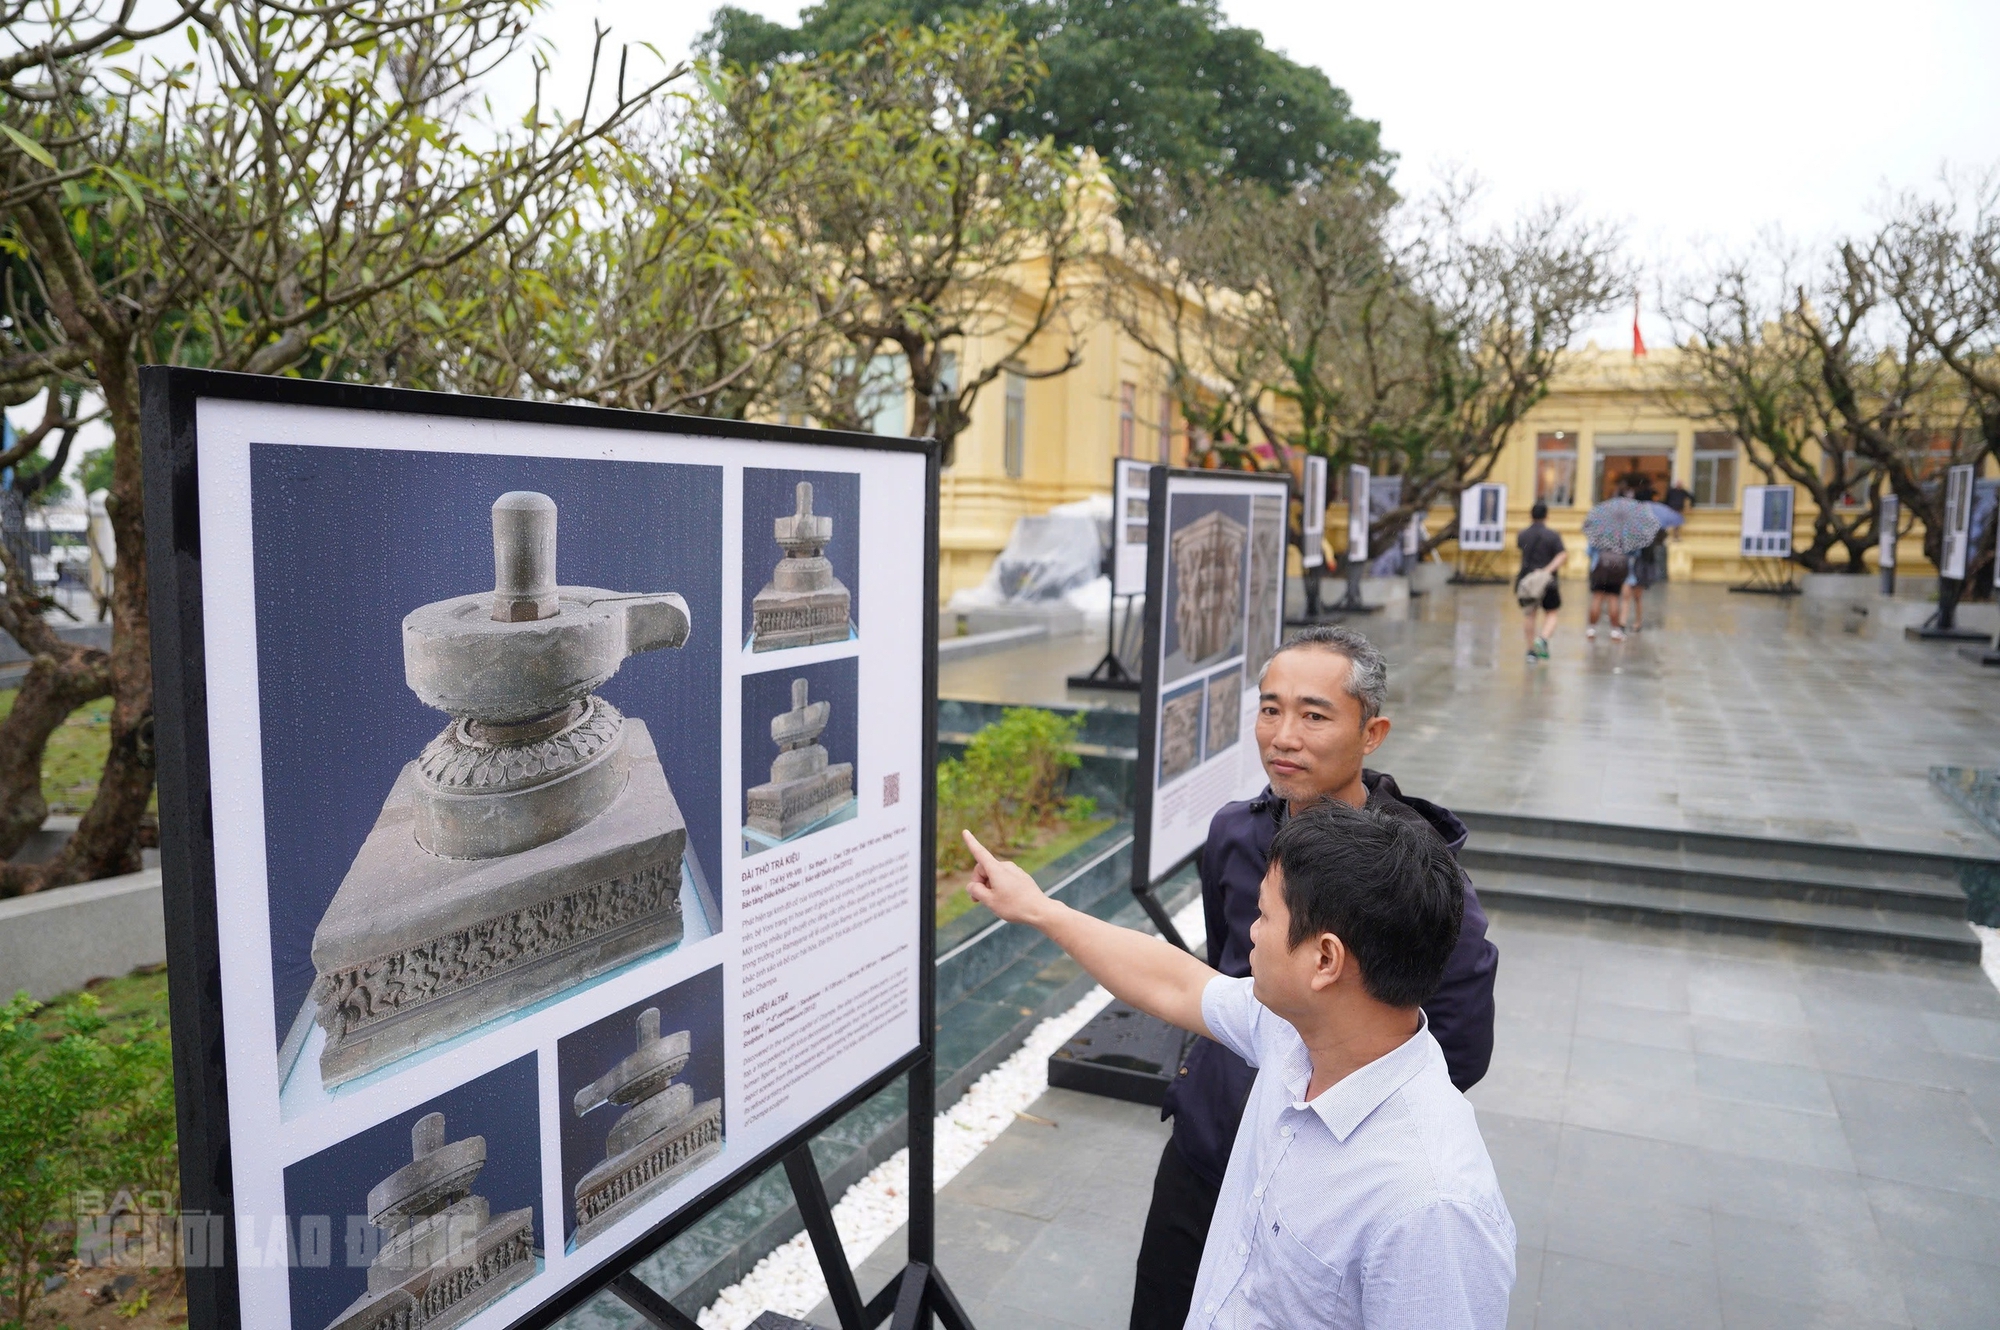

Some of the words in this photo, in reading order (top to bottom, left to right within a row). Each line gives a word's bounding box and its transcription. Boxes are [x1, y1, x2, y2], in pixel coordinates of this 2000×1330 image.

[742, 868, 753, 882] ĐÀI
[755, 862, 769, 877] THỜ
[771, 857, 784, 871] TRÀ
[786, 851, 800, 866] KIỆU
[743, 1009, 754, 1023] TRÀ
[756, 1001, 770, 1017] KIỆU
[771, 992, 789, 1008] ALTAR
